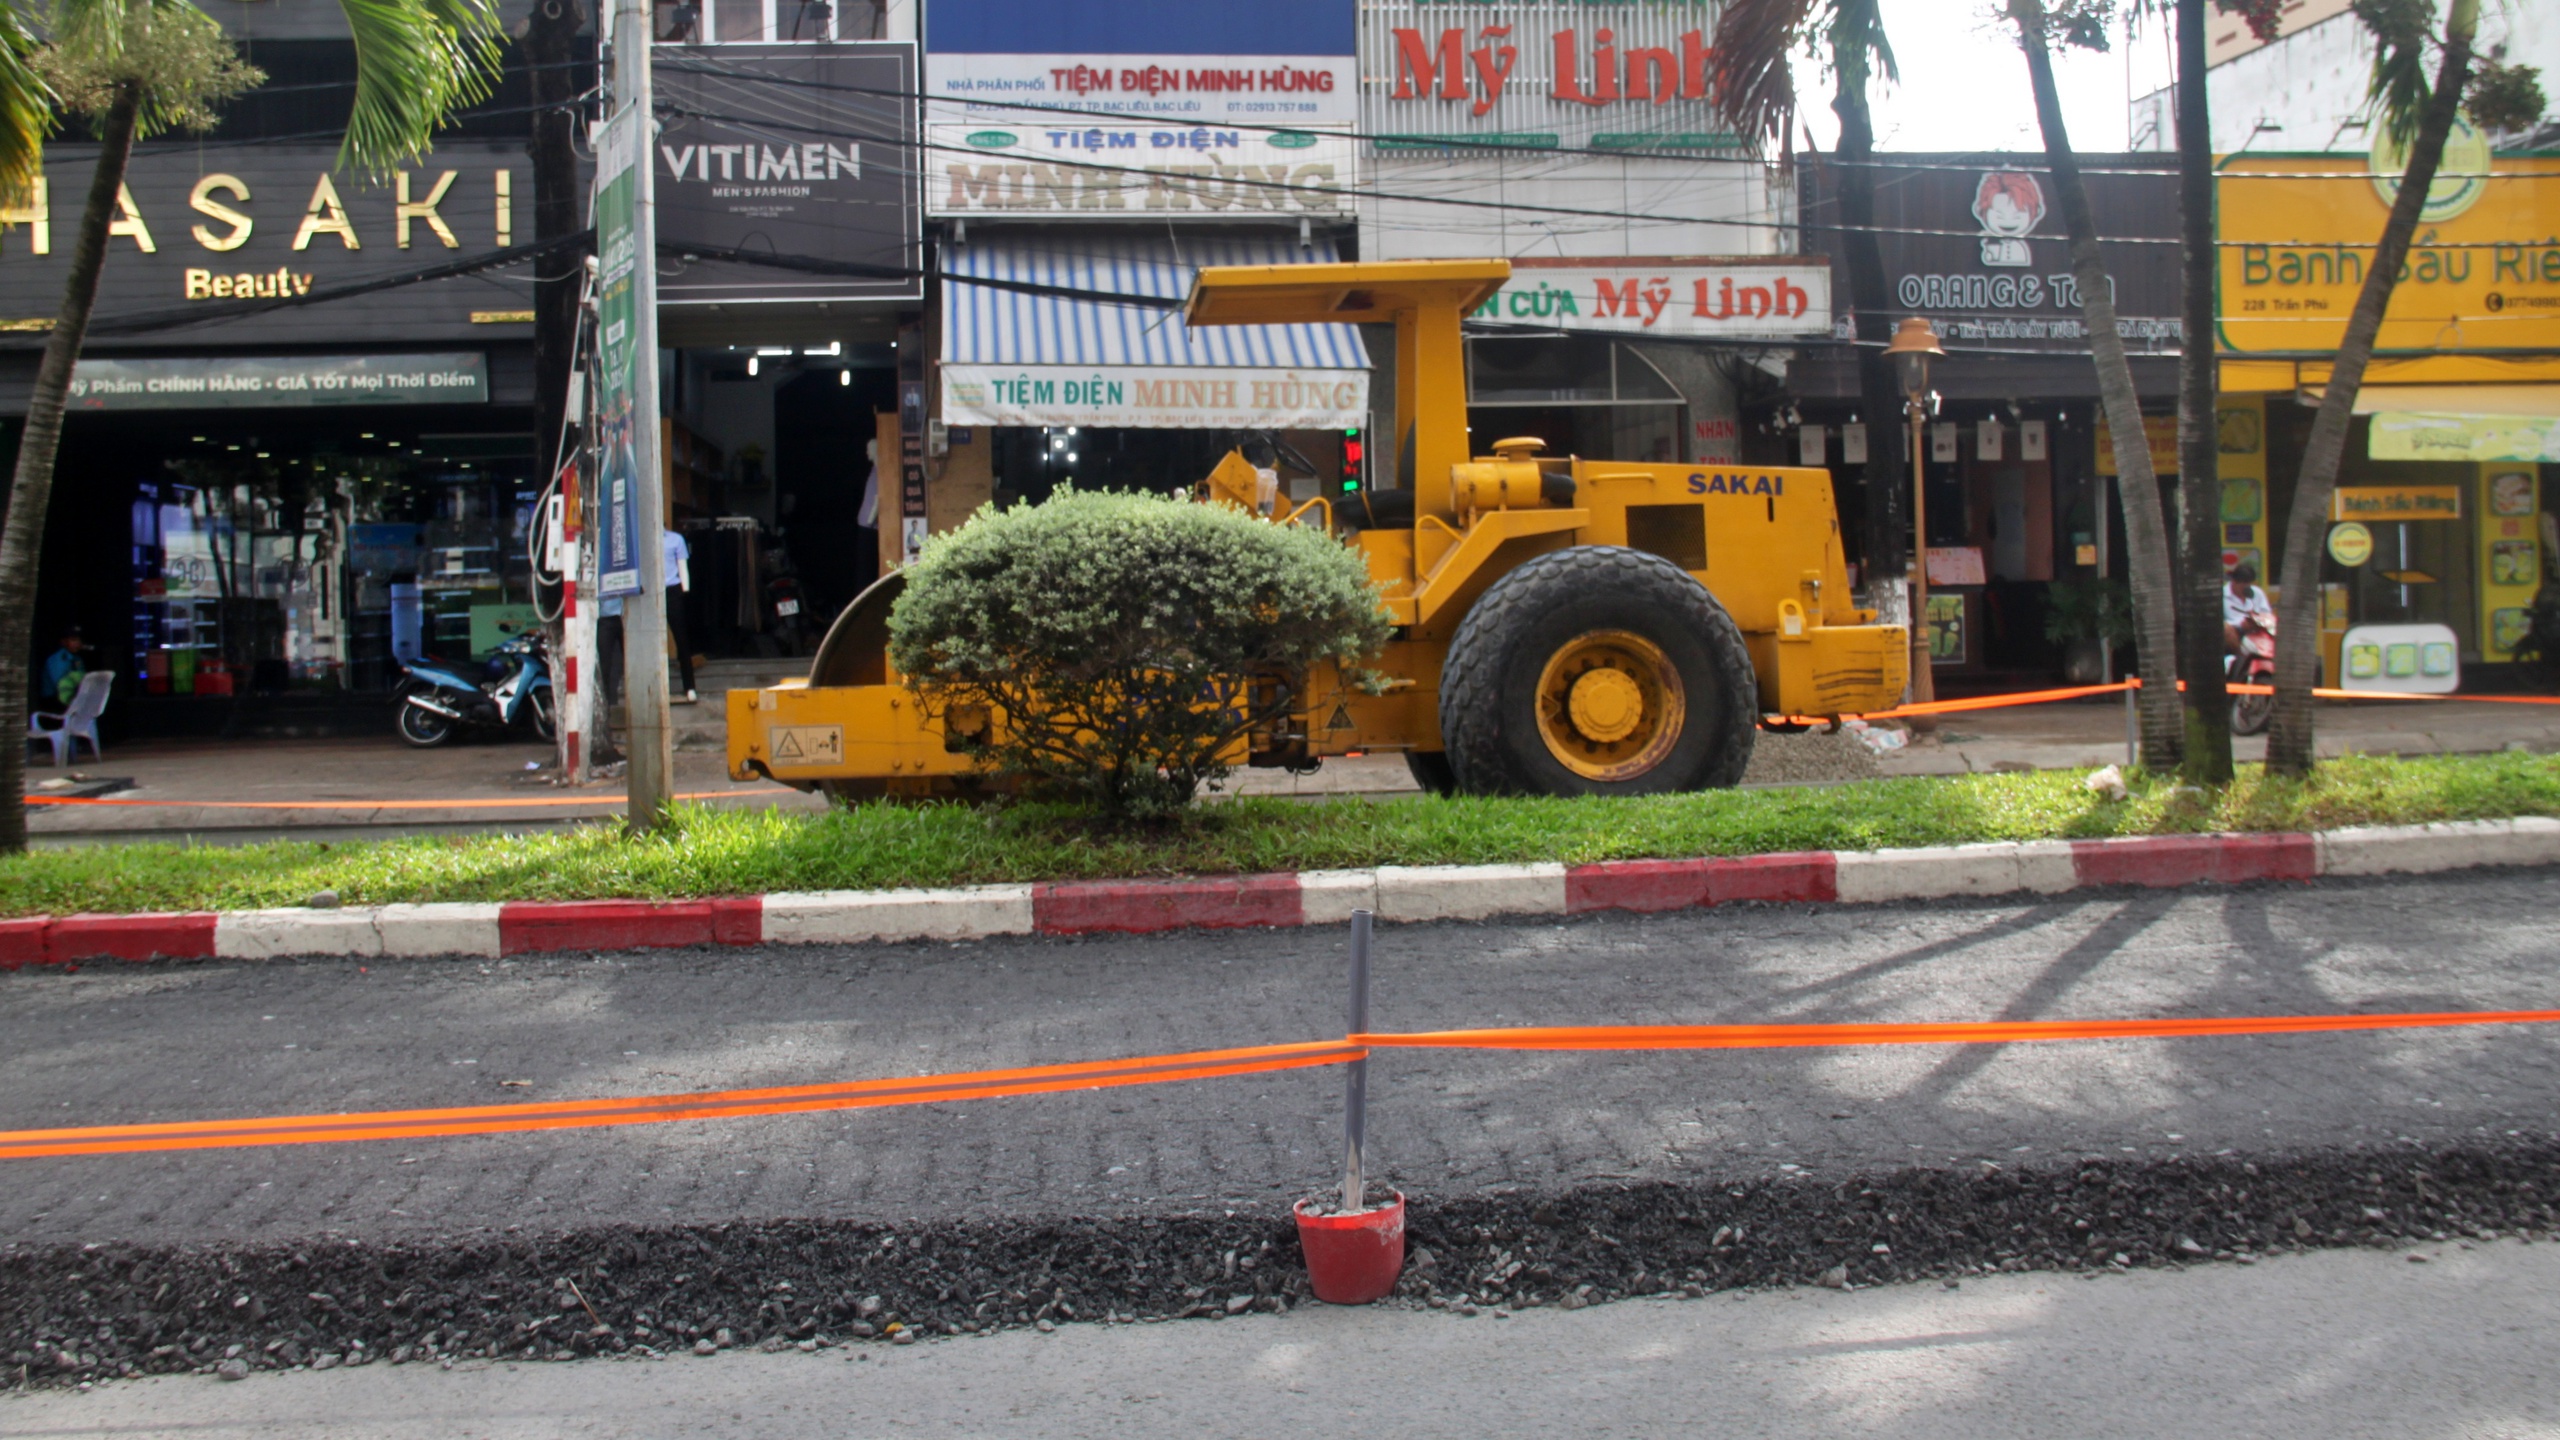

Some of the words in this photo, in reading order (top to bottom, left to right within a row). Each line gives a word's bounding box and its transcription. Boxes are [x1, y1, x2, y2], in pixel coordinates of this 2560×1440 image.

[947, 79, 974, 91] NHÀ
[976, 79, 1013, 91] PHÂN
[1015, 78, 1045, 91] PHỐI
[1050, 64, 1113, 97] TIỆM
[1120, 65, 1180, 97] ĐIỆN
[1186, 69, 1254, 93] MINH
[1260, 65, 1334, 93] HÙNG
[1391, 24, 1517, 117] Mỹ
[1045, 128, 1136, 153] TIỆM
[1150, 128, 1239, 153] ĐIỆN
[662, 143, 860, 182] VITIMEN
[712, 187, 752, 197] MEN'S
[754, 186, 810, 197] FASHION
[946, 163, 1126, 210] MINH
[1143, 153, 1336, 211] HÙNG
[2240, 238, 2362, 286] Bánh
[1509, 281, 1580, 317] CỬA
[1592, 276, 1672, 327] Mỹ
[1692, 276, 1809, 321] Linh
[147, 375, 204, 393] CHÍNH
[276, 372, 308, 390] GIÁ
[312, 371, 348, 389] TỐT
[352, 373, 383, 391] Mọi
[387, 372, 425, 387] Thời
[992, 374, 1054, 409] TIỆM
[1064, 374, 1123, 410] ĐIỆN
[1133, 379, 1236, 408] MINH
[1250, 372, 1358, 410] HÙNG
[1687, 473, 1783, 496] SAKAI
